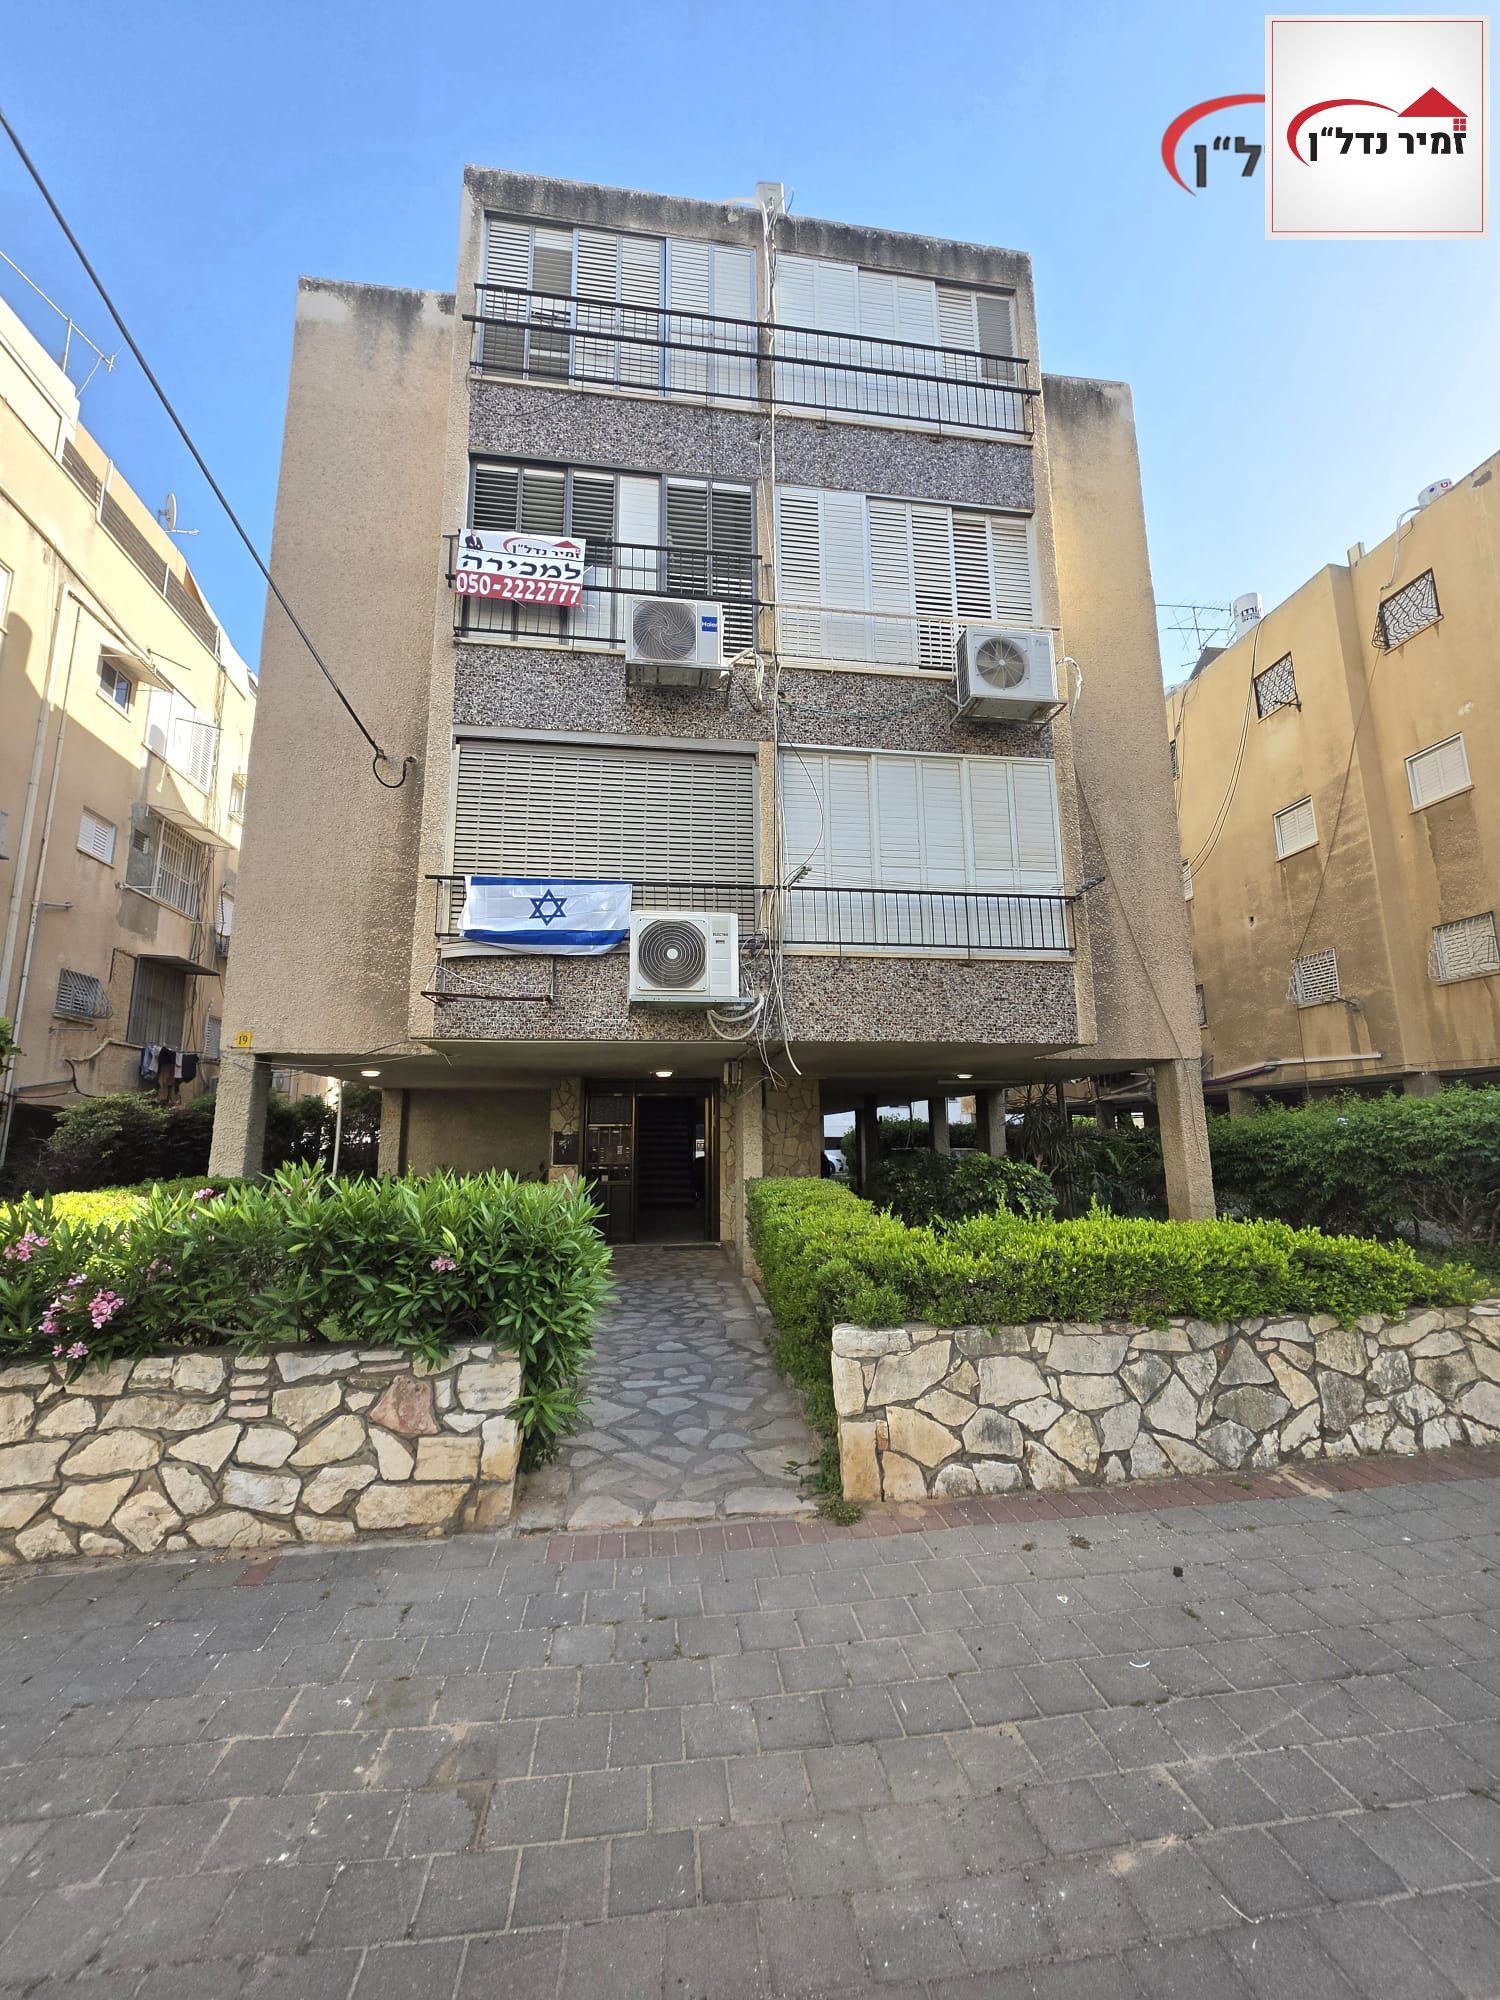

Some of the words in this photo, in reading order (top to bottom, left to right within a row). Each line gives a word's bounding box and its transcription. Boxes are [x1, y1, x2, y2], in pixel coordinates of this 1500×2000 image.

[551, 549, 580, 559] זמיר
[462, 554, 581, 580] למכירה
[456, 572, 581, 605] 050-2222777
[238, 1035, 248, 1045] 19
